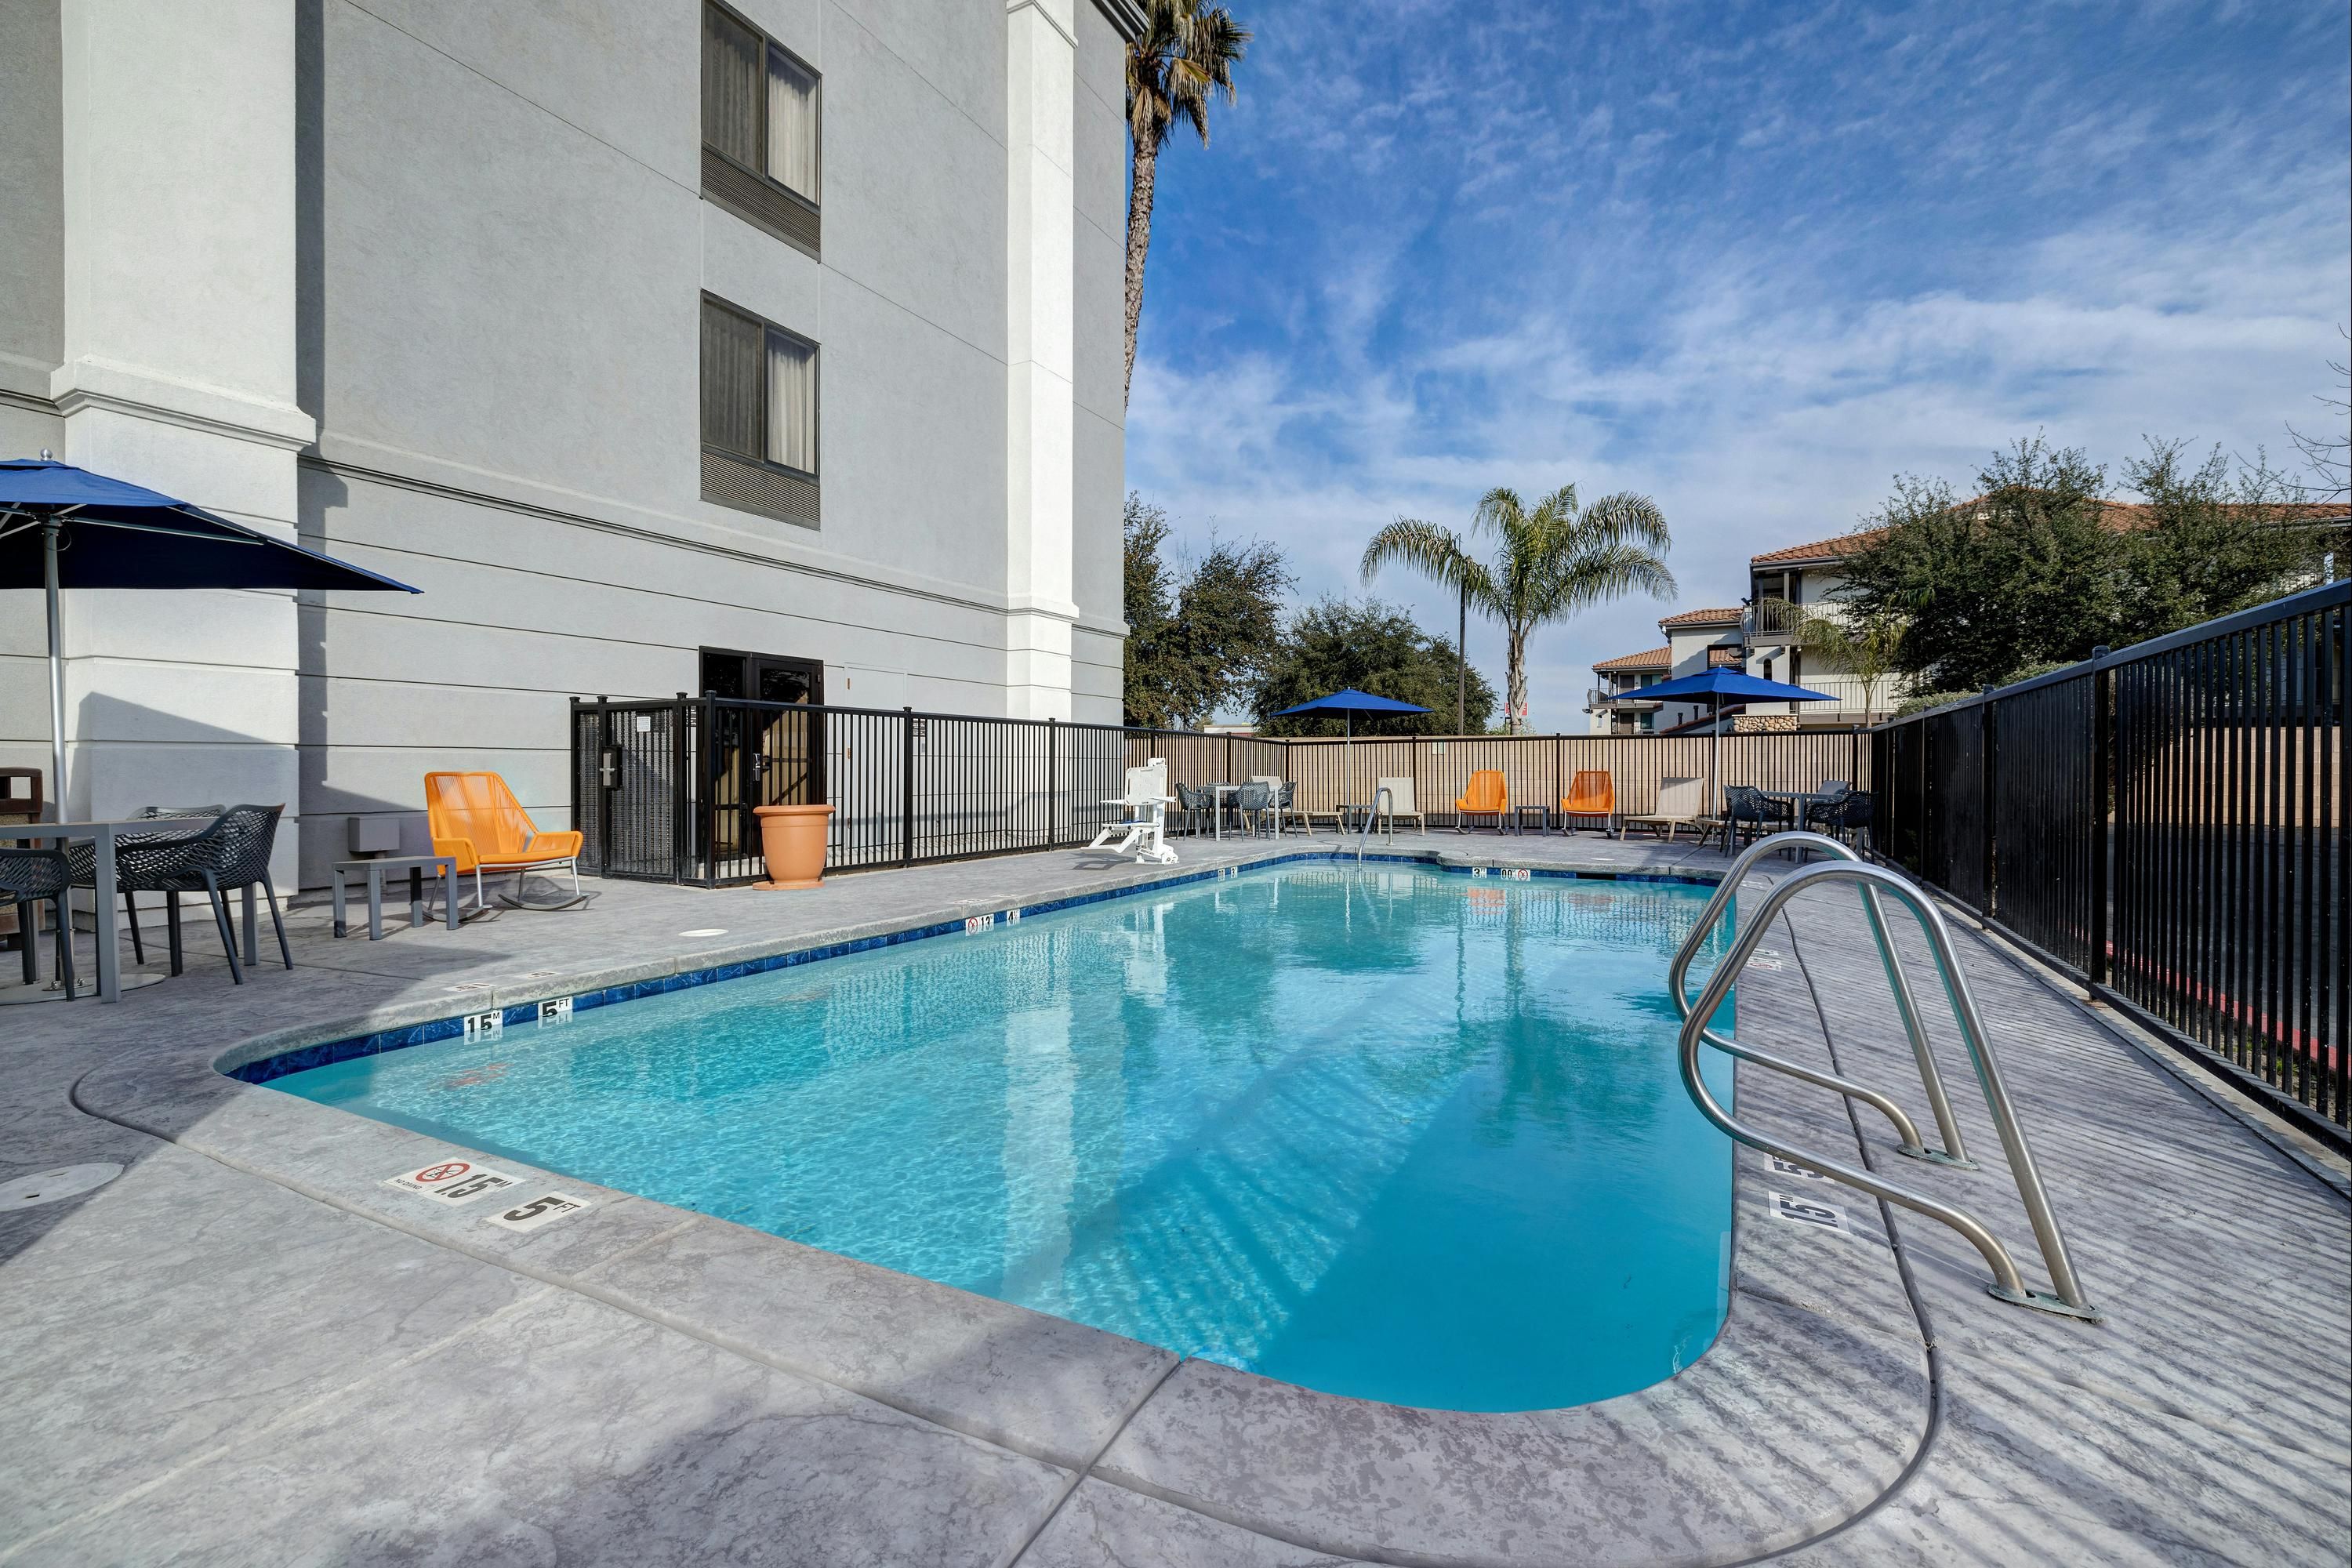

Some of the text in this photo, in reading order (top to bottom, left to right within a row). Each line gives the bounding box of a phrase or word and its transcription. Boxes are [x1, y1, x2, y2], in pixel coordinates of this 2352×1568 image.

[542, 998, 569, 1018] 5 FT
[503, 1196, 582, 1221] 5 FT
